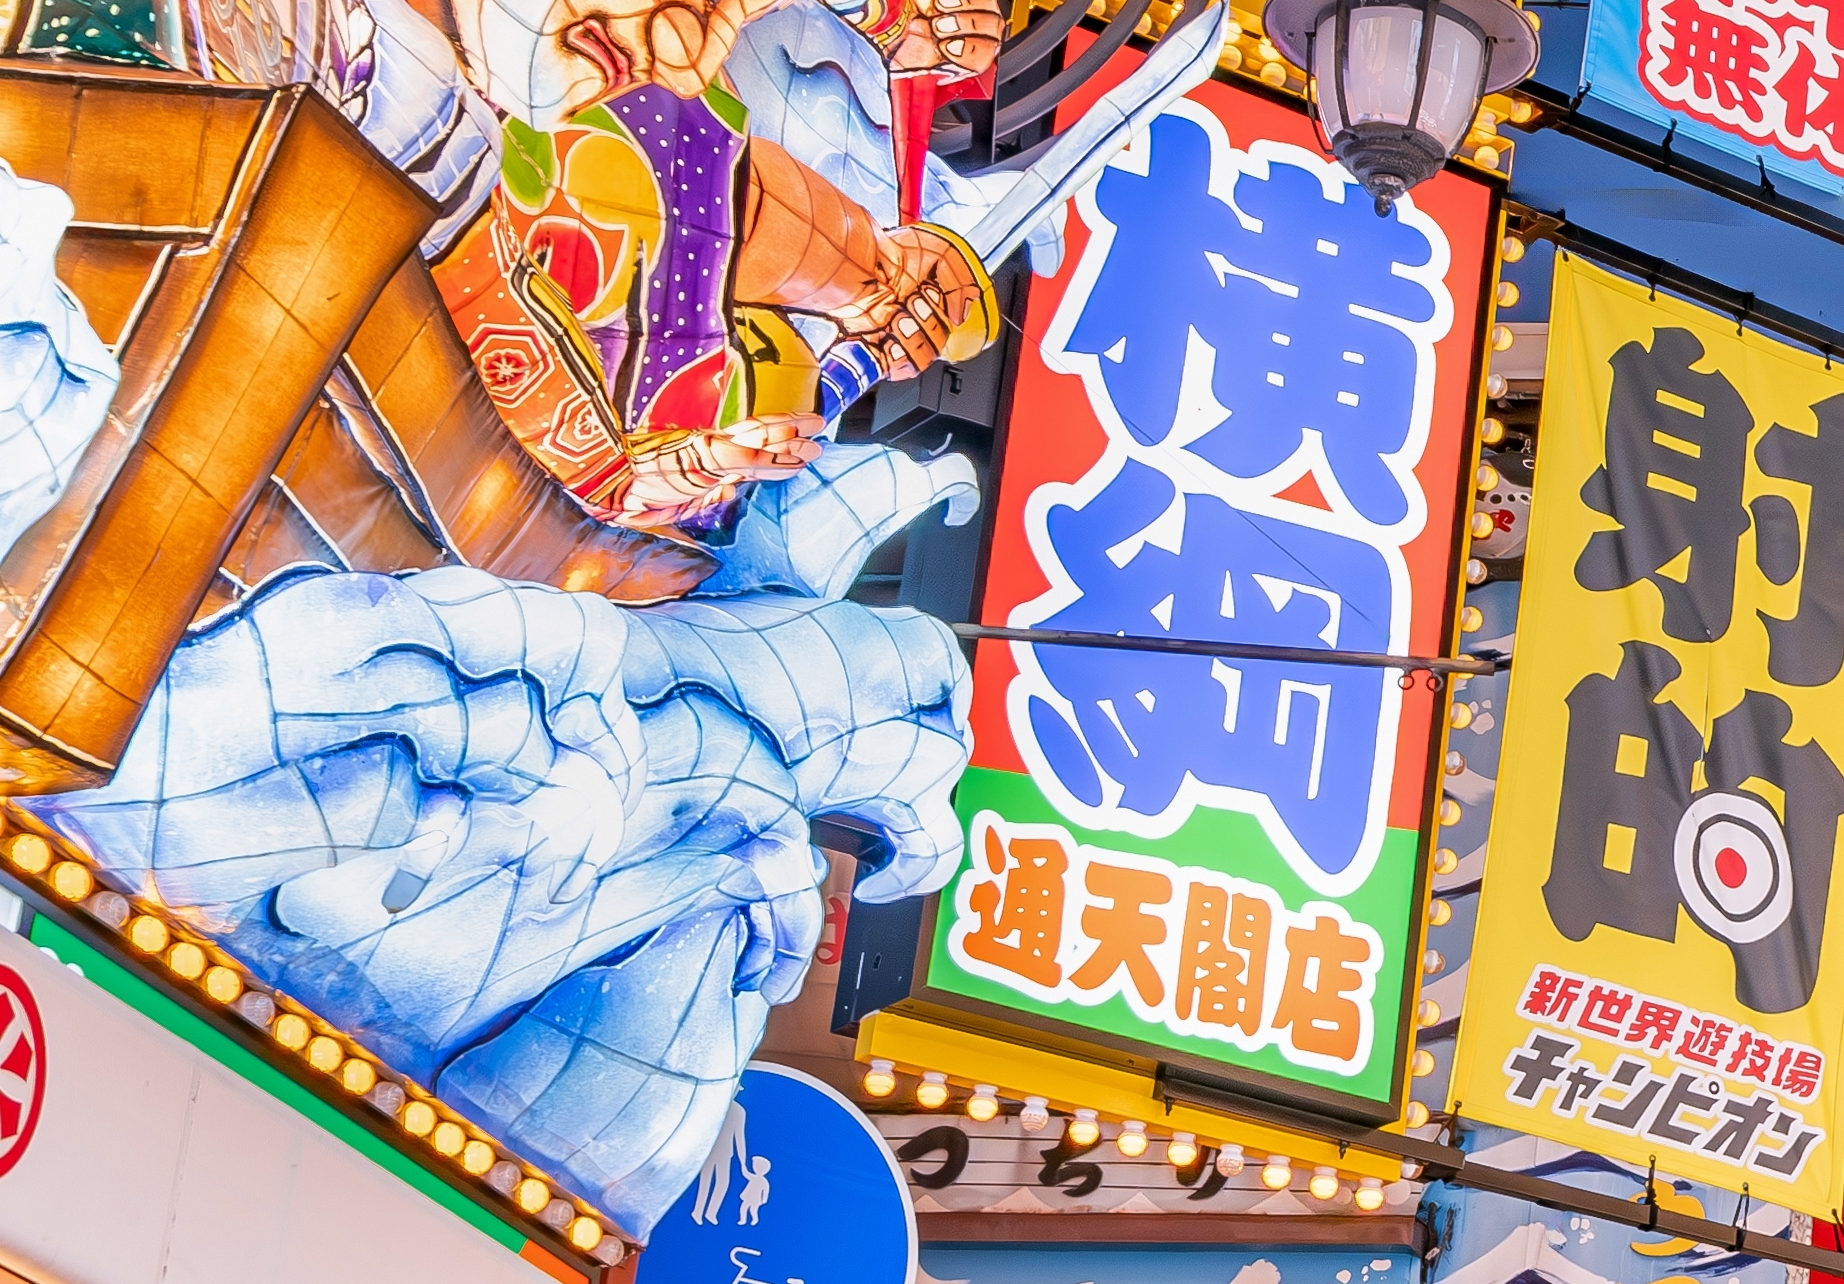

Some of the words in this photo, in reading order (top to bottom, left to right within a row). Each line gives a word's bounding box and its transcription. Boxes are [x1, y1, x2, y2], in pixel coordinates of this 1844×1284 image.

[1023, 120, 1436, 878] 横綱
[967, 831, 1376, 1065] 通天閣店
[1522, 973, 1826, 1098] 新世界遊技場
[1502, 1039, 1823, 1180] チャンピオン
